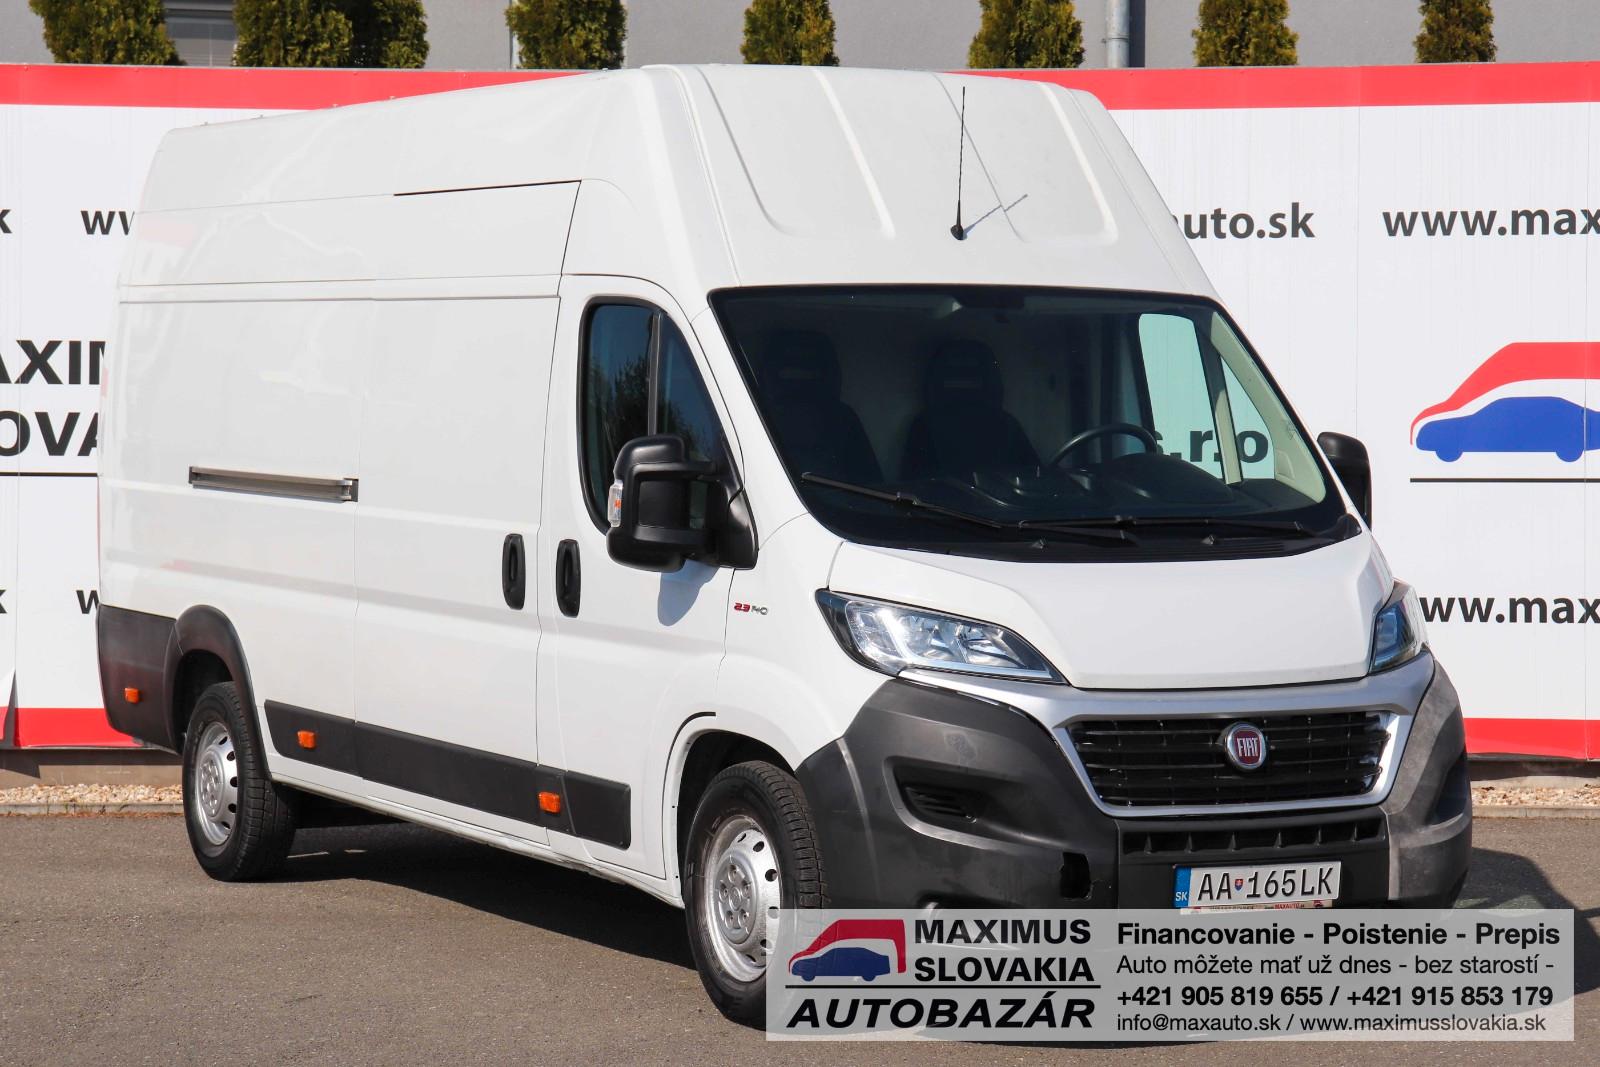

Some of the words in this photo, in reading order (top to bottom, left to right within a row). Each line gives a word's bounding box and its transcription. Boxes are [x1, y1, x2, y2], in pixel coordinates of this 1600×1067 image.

[1172, 202, 1315, 239] uto.sk
[1382, 208, 1600, 237] www.max
[0, 340, 106, 384] XI
[1236, 737, 1259, 757] FIAT
[1175, 891, 1188, 902] SK
[1197, 872, 1232, 901] AA
[1246, 867, 1333, 899] 165LK
